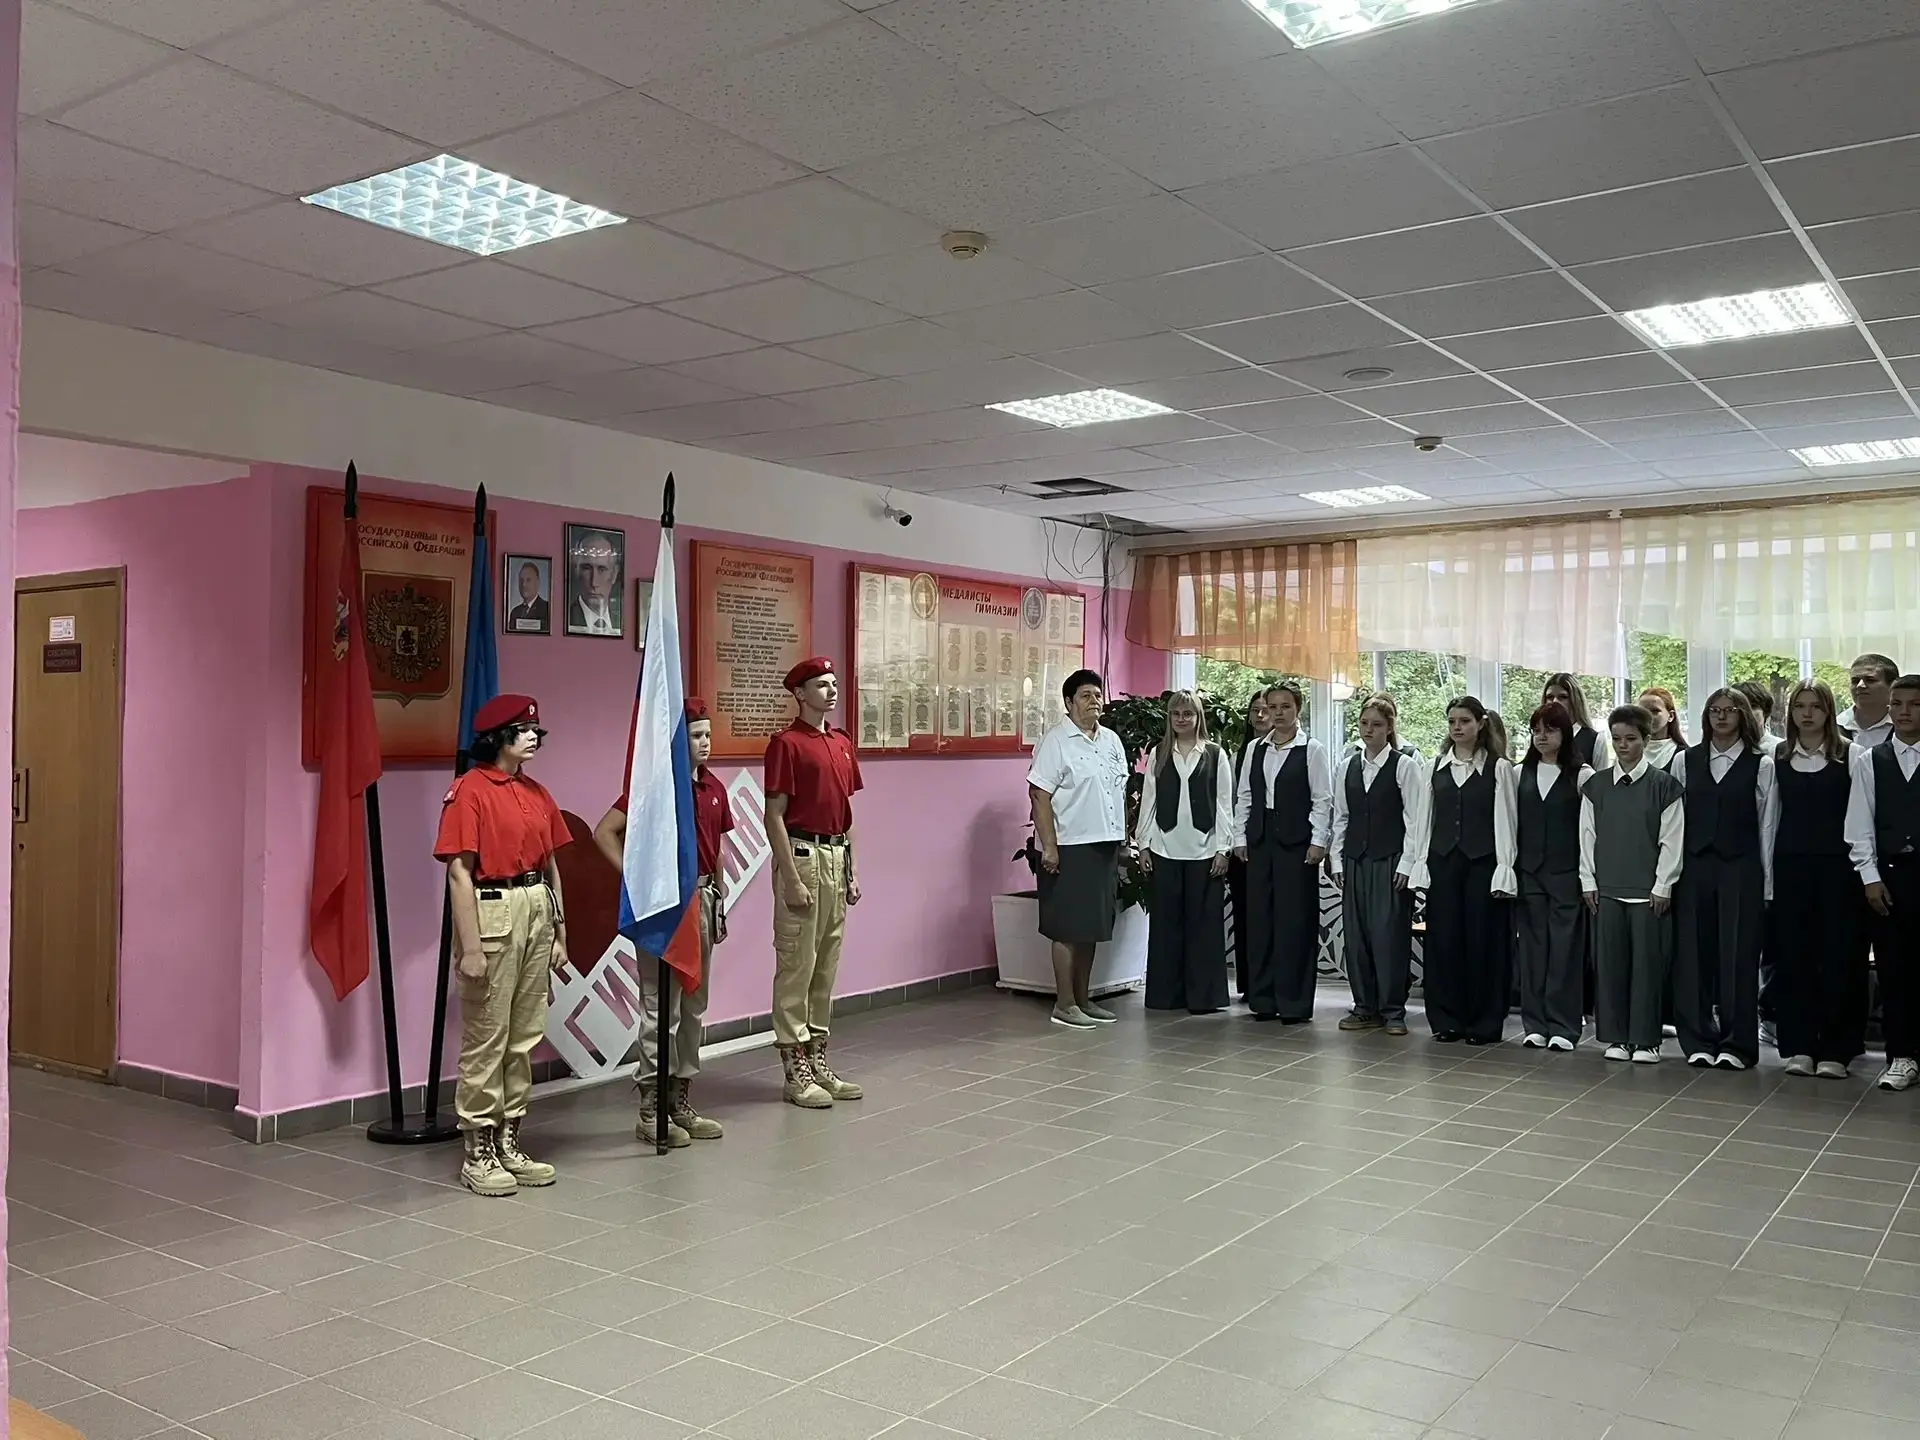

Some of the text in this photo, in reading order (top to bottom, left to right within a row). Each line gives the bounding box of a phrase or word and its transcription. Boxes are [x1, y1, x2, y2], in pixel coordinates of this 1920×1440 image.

[357, 524, 437, 541] ОСУДАРСТВЕННЫЙ
[358, 537, 409, 551] ССИЙСКОЙ
[942, 587, 992, 603] МЕДАЛИСТЫ
[975, 603, 1018, 617] ГИМНАЗИИ
